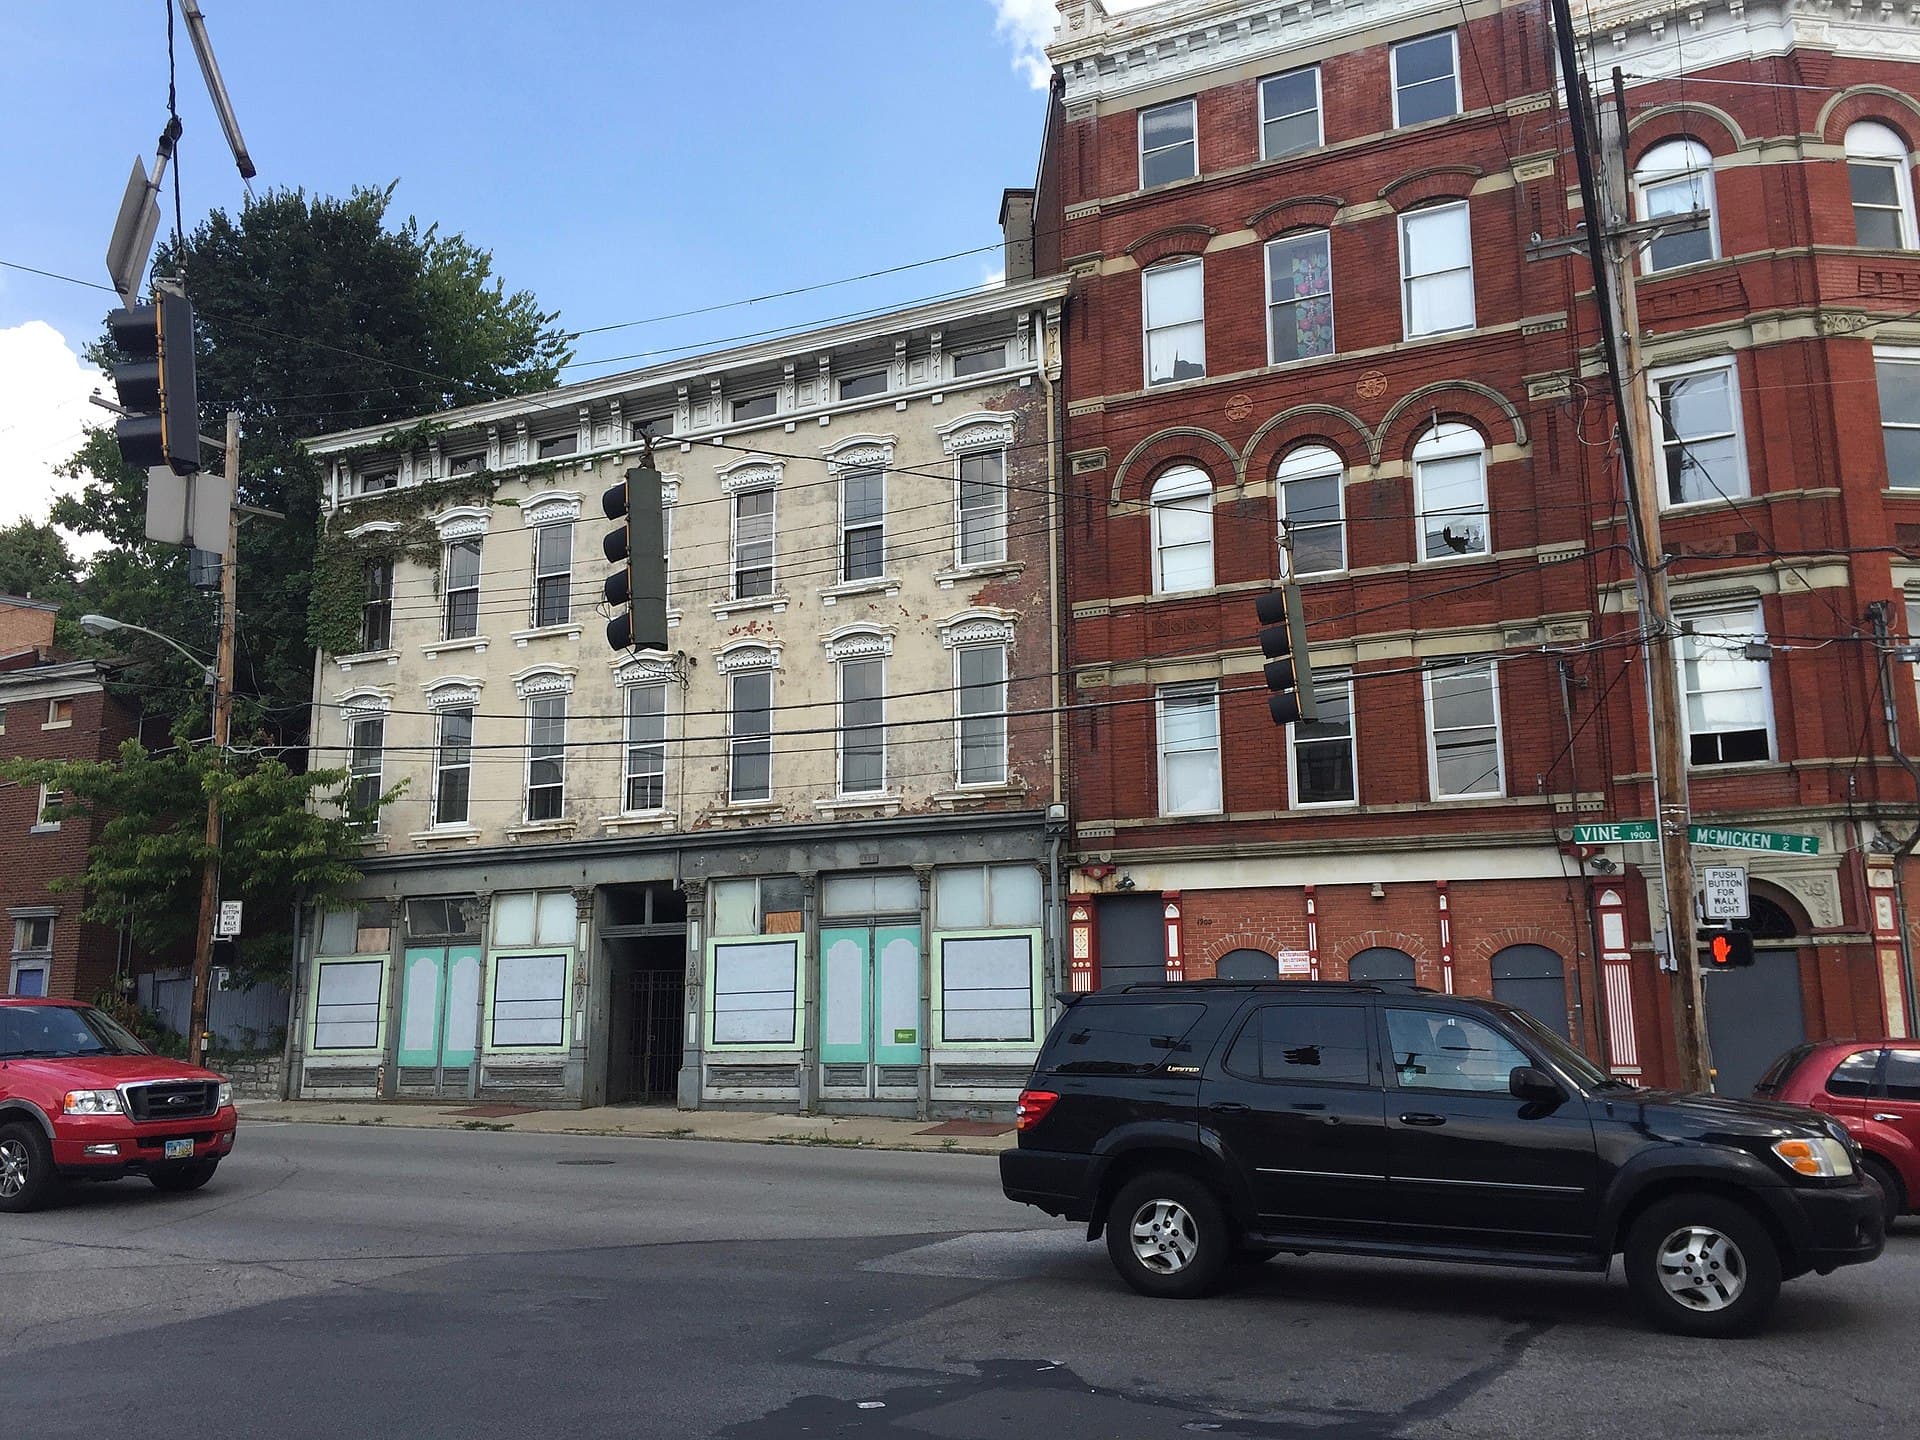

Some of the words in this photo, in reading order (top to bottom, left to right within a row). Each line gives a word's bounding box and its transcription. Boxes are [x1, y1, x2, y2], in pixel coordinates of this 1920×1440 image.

[1580, 826, 1622, 841] VINE
[1630, 831, 1651, 839] 1900
[1801, 838, 1811, 852] E
[1712, 871, 1737, 879] PUSH
[1708, 880, 1742, 888] BUTTON
[1717, 888, 1735, 896] FOR
[1713, 897, 1740, 905] WALK
[1714, 906, 1740, 914] LIGHT
